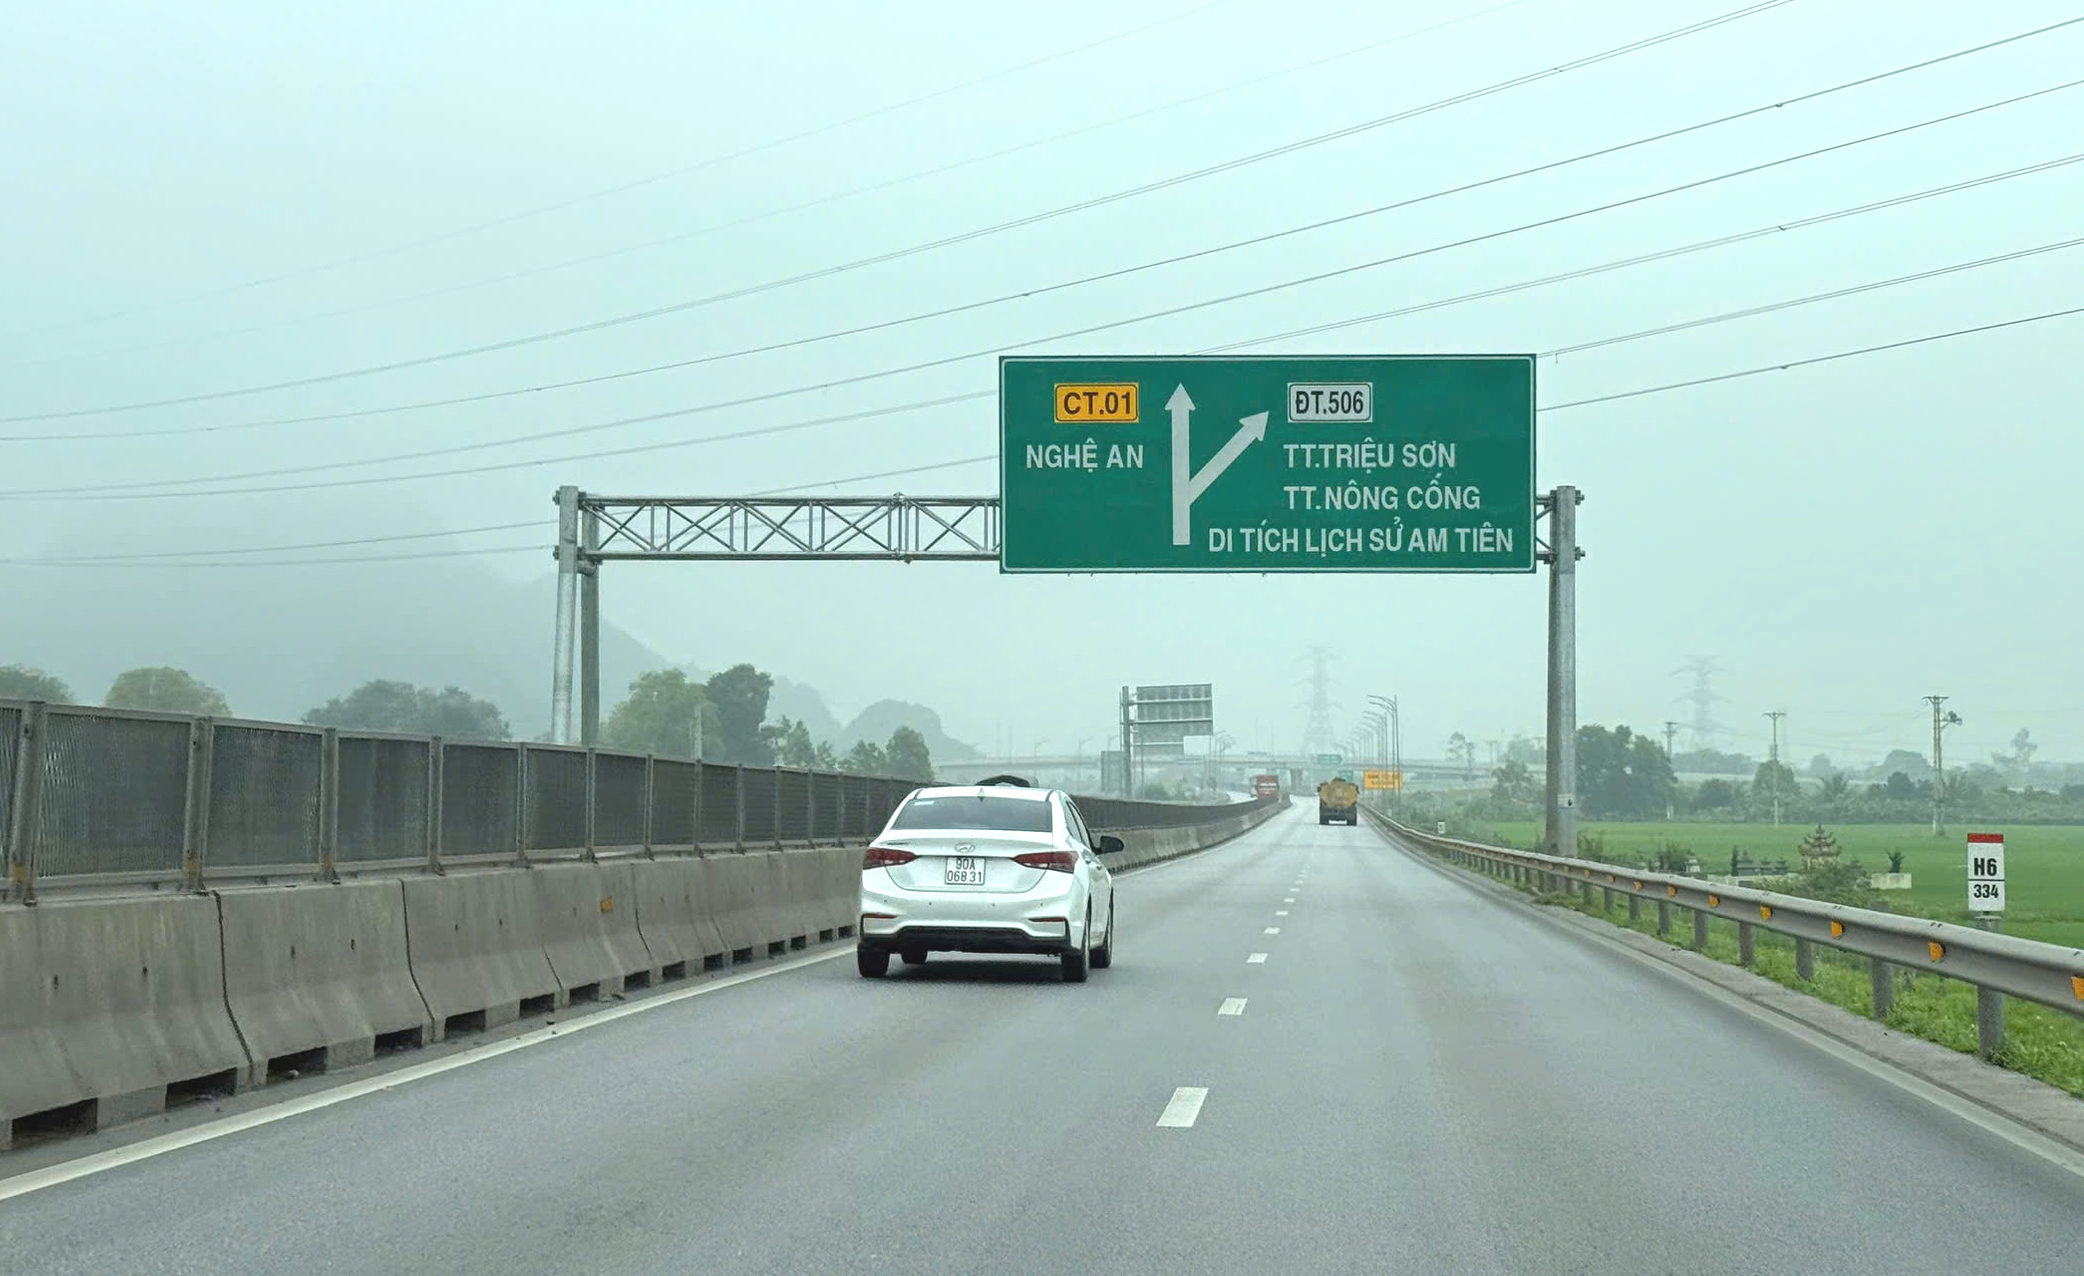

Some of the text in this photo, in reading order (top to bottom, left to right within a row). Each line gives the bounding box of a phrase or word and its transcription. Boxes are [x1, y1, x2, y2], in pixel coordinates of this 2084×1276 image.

[1063, 391, 1131, 415] CT.01
[1295, 390, 1364, 415] ĐT.506
[1026, 437, 1144, 473] NGHỆ AN
[1402, 440, 1456, 468] SƠN
[1406, 473, 1480, 510] CỐNG
[1208, 516, 1513, 558] DI TÍCH LỊCH SỬ AM TIÊN
[956, 857, 975, 870] 90A
[1974, 857, 1997, 876] H6
[1973, 884, 1998, 898] 334
